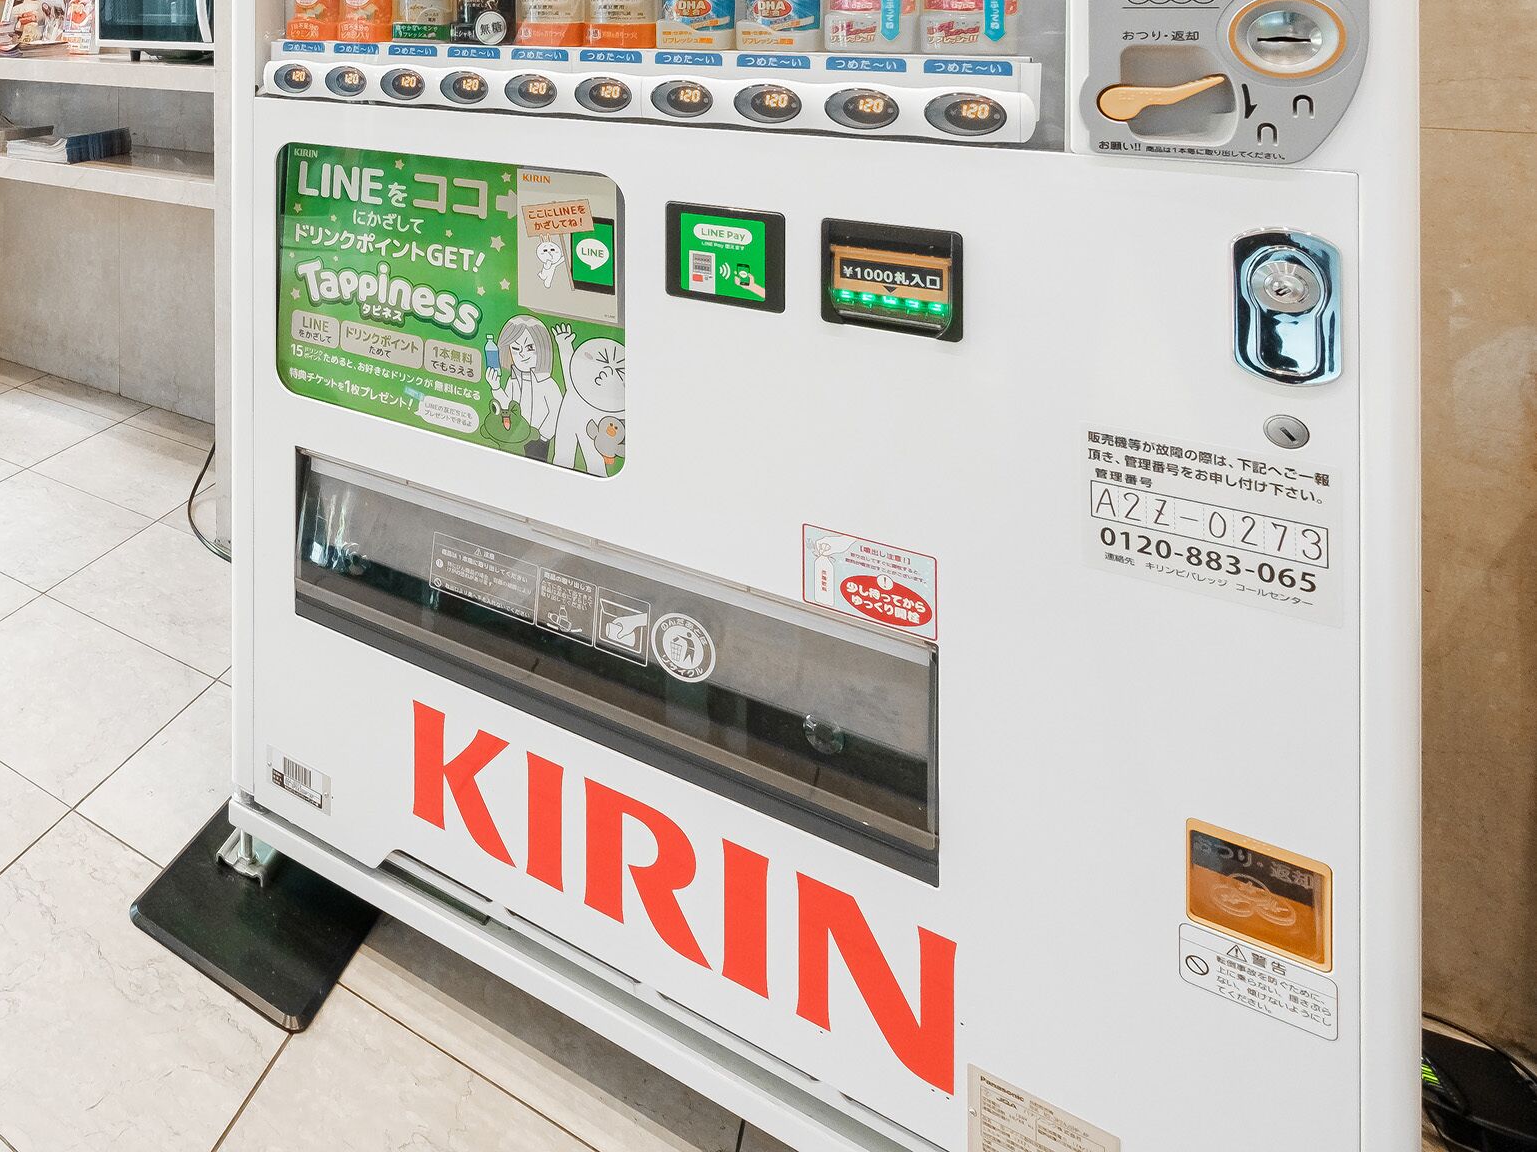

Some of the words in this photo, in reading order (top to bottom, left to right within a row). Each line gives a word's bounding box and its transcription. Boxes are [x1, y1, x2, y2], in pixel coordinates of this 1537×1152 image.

[677, 0, 706, 10] DHA
[757, 0, 786, 10] DHA
[479, 21, 504, 36] 無糖
[1122, 30, 1200, 42] おつり・返却
[292, 70, 305, 81] 120
[345, 73, 359, 84] 120
[401, 76, 417, 88] 120
[462, 79, 479, 91] 120
[529, 83, 546, 95] 120
[601, 85, 620, 97] 120
[680, 89, 701, 102] 120
[765, 93, 788, 106] 120
[858, 98, 884, 113] 120
[961, 103, 990, 119] 120
[294, 148, 319, 159] KIRIN
[1098, 140, 1142, 152] お願い!!
[1145, 145, 1286, 161] 商品は1本毎に取り出してください。
[522, 173, 552, 185] KIRIN
[297, 160, 489, 221] LINEをココ
[527, 204, 587, 221] ここにLINEを
[353, 209, 425, 235] にかざして
[533, 217, 584, 231] かざしてね!
[700, 226, 725, 239] LINE
[726, 230, 746, 242] Pay
[294, 223, 486, 273] ドリンクポイントGET!
[581, 246, 604, 259] LINE
[842, 264, 941, 289] ¥1000札入口
[296, 257, 480, 335] Tappiness
[362, 304, 403, 322] タピネス
[302, 316, 329, 333] LINE
[298, 329, 332, 344] をかざして
[346, 326, 419, 354] ドリンクポイント
[368, 346, 392, 359] ためて
[433, 346, 473, 365] 1本無料
[431, 360, 475, 378] でもらえる
[289, 367, 414, 411] 特典チケットを1枚プレゼント!
[424, 402, 473, 420] LINEの友だちにも
[424, 409, 473, 428] プレゼントできるよ
[1087, 431, 1330, 487] 販売機等が故障の際は、下記へご一報
[1088, 448, 1323, 505] 頂き、管理番号をお申し付け下さい。
[1095, 468, 1153, 488] 管理番号
[1100, 527, 1317, 593] 0120-883-065
[1104, 551, 1135, 566] 連絡先
[1145, 562, 1228, 587] キリンビバレッジ
[1236, 583, 1313, 605] コールセンター
[846, 582, 926, 613] 少し待ってから
[851, 594, 920, 624] ゆっくり開栓
[662, 654, 703, 677] リサイクル
[412, 699, 957, 1096] KIRIN
[1251, 952, 1286, 976] 警告
[1216, 955, 1325, 1005] 転倒事故を防ぐために、
[1217, 985, 1272, 1014] てください。
[980, 1075, 1025, 1103] Panasonic
